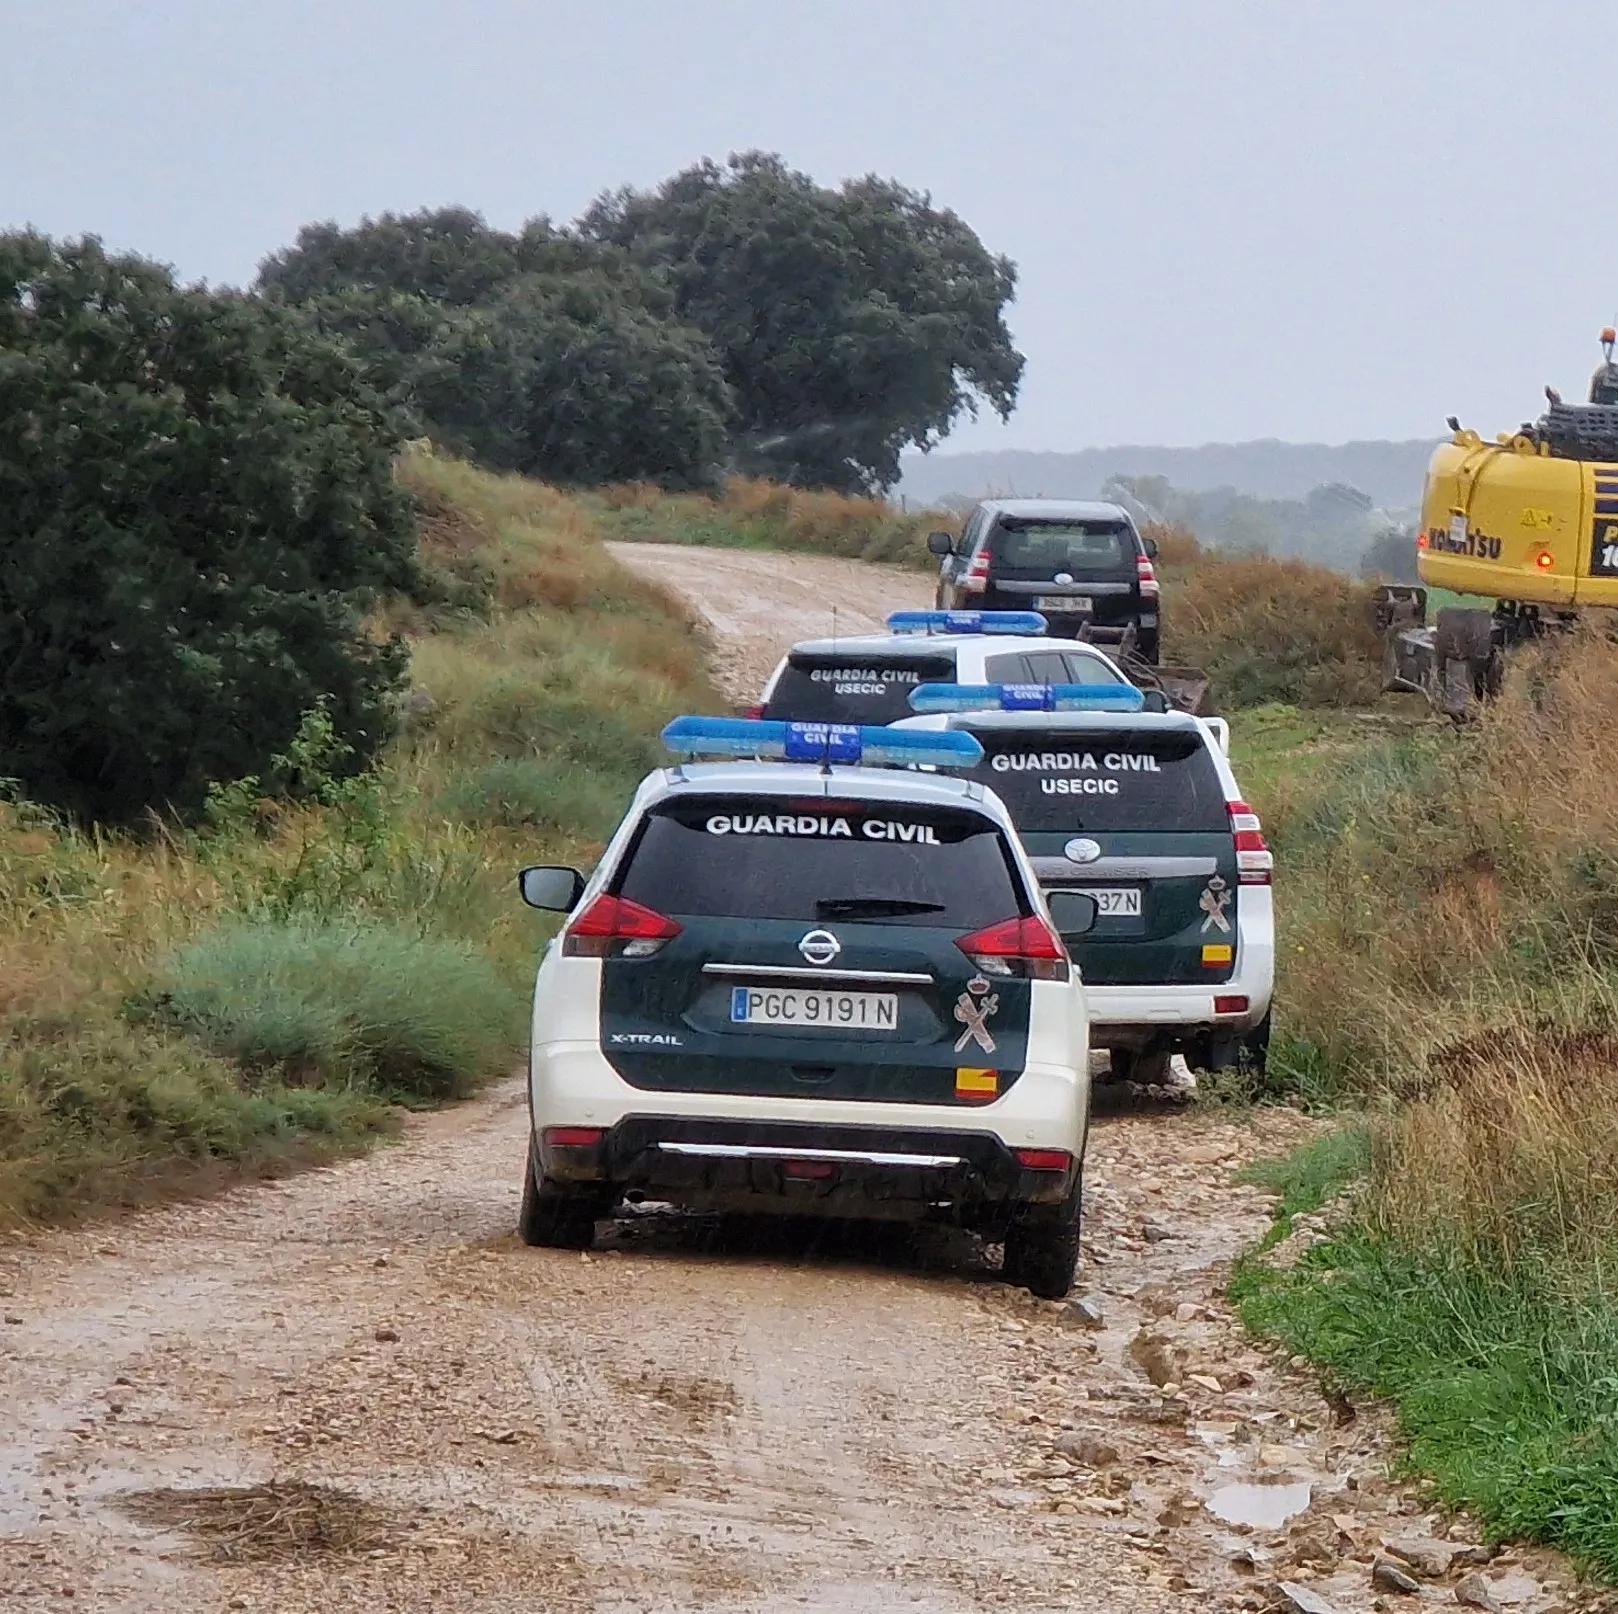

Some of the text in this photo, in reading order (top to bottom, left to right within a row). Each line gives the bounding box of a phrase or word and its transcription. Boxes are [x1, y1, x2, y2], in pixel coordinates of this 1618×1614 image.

[810, 669, 920, 683] GUARDIA CIVIL
[835, 683, 887, 694] USECIC
[992, 753, 1161, 772] GUARDIA CIVIL
[1041, 778, 1119, 794] USECIC
[706, 815, 941, 845] GUARDIA CIVIL
[749, 993, 893, 1024] PGC 9191 N
[609, 1033, 684, 1046] X-TRAIL
